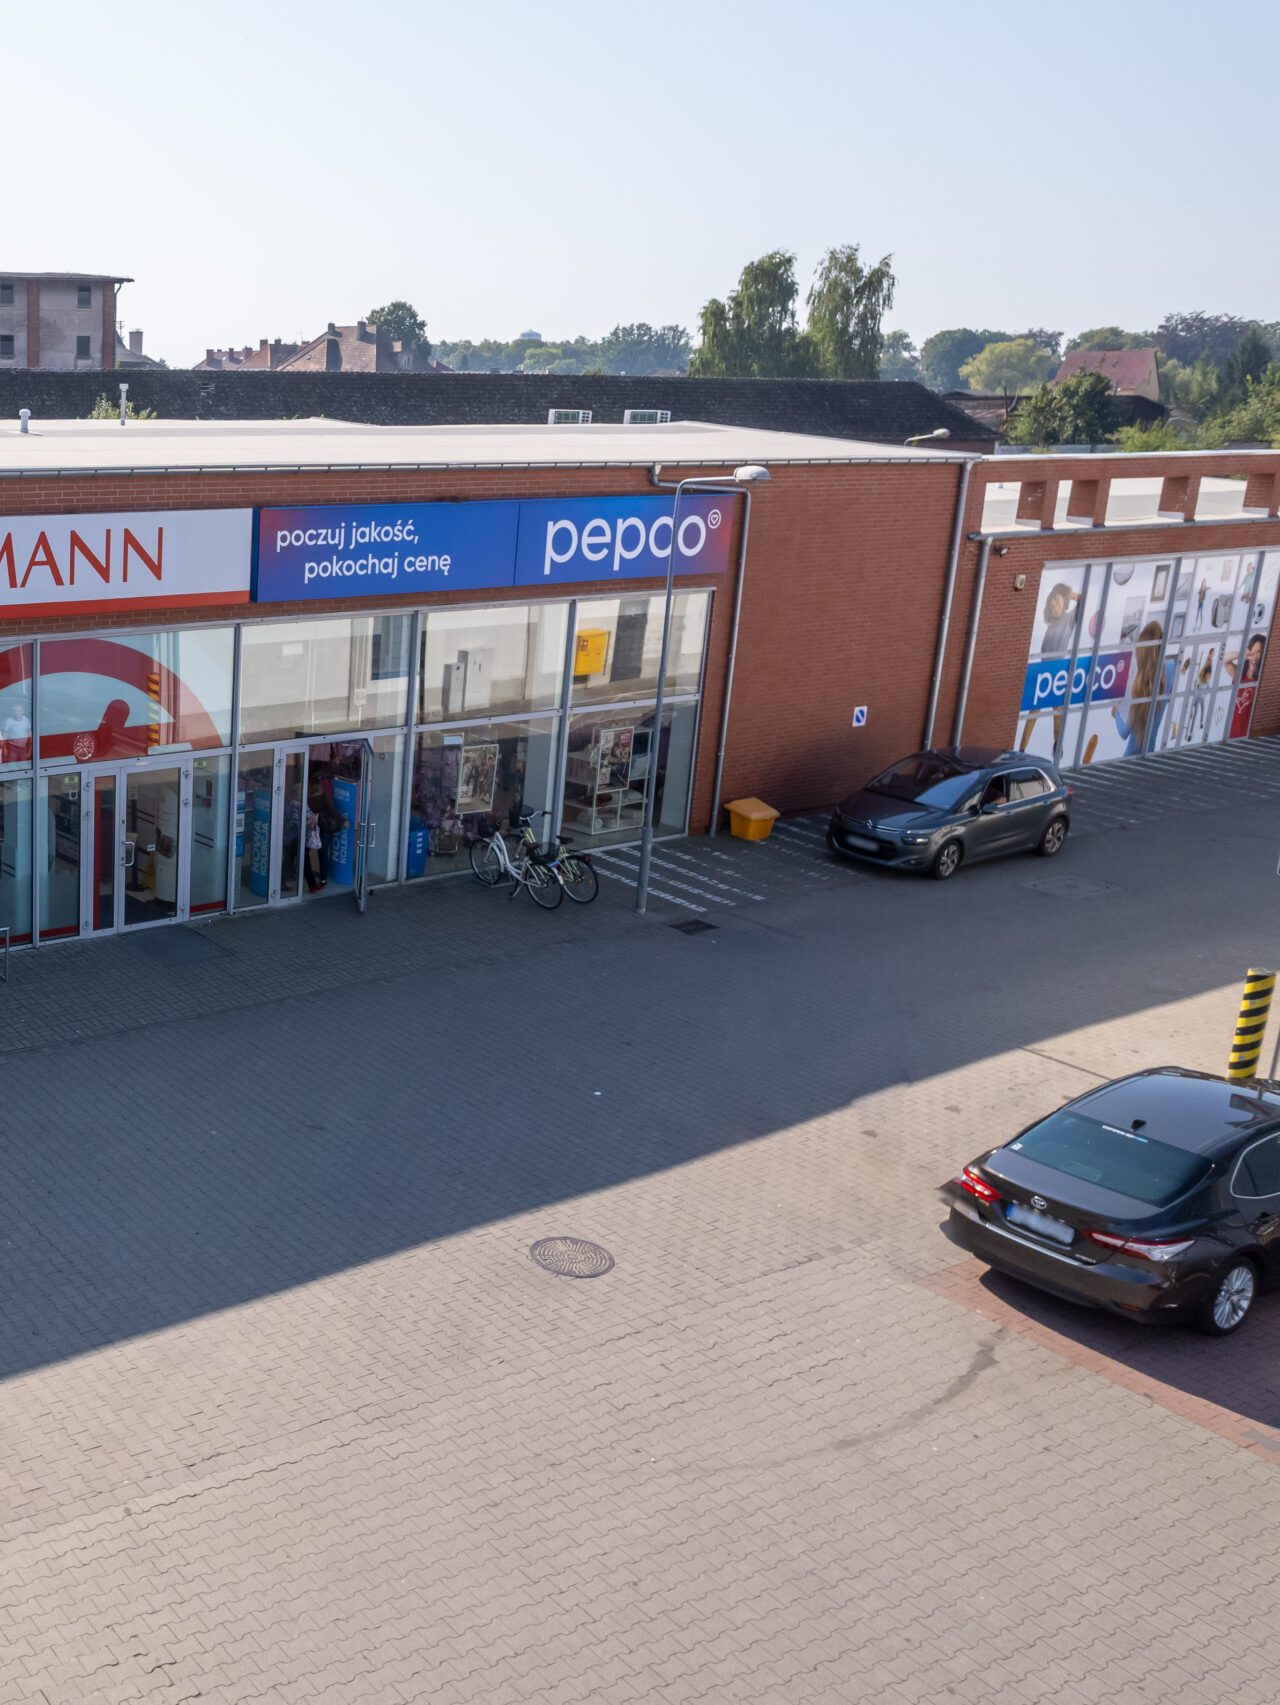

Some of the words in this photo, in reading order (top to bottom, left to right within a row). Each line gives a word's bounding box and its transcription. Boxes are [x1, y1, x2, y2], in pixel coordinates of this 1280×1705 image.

[276, 522, 346, 552] poczuj
[349, 519, 419, 550] jakość,
[543, 514, 707, 575] pepco
[304, 551, 399, 584] pokochaj
[403, 554, 451, 576] cenę
